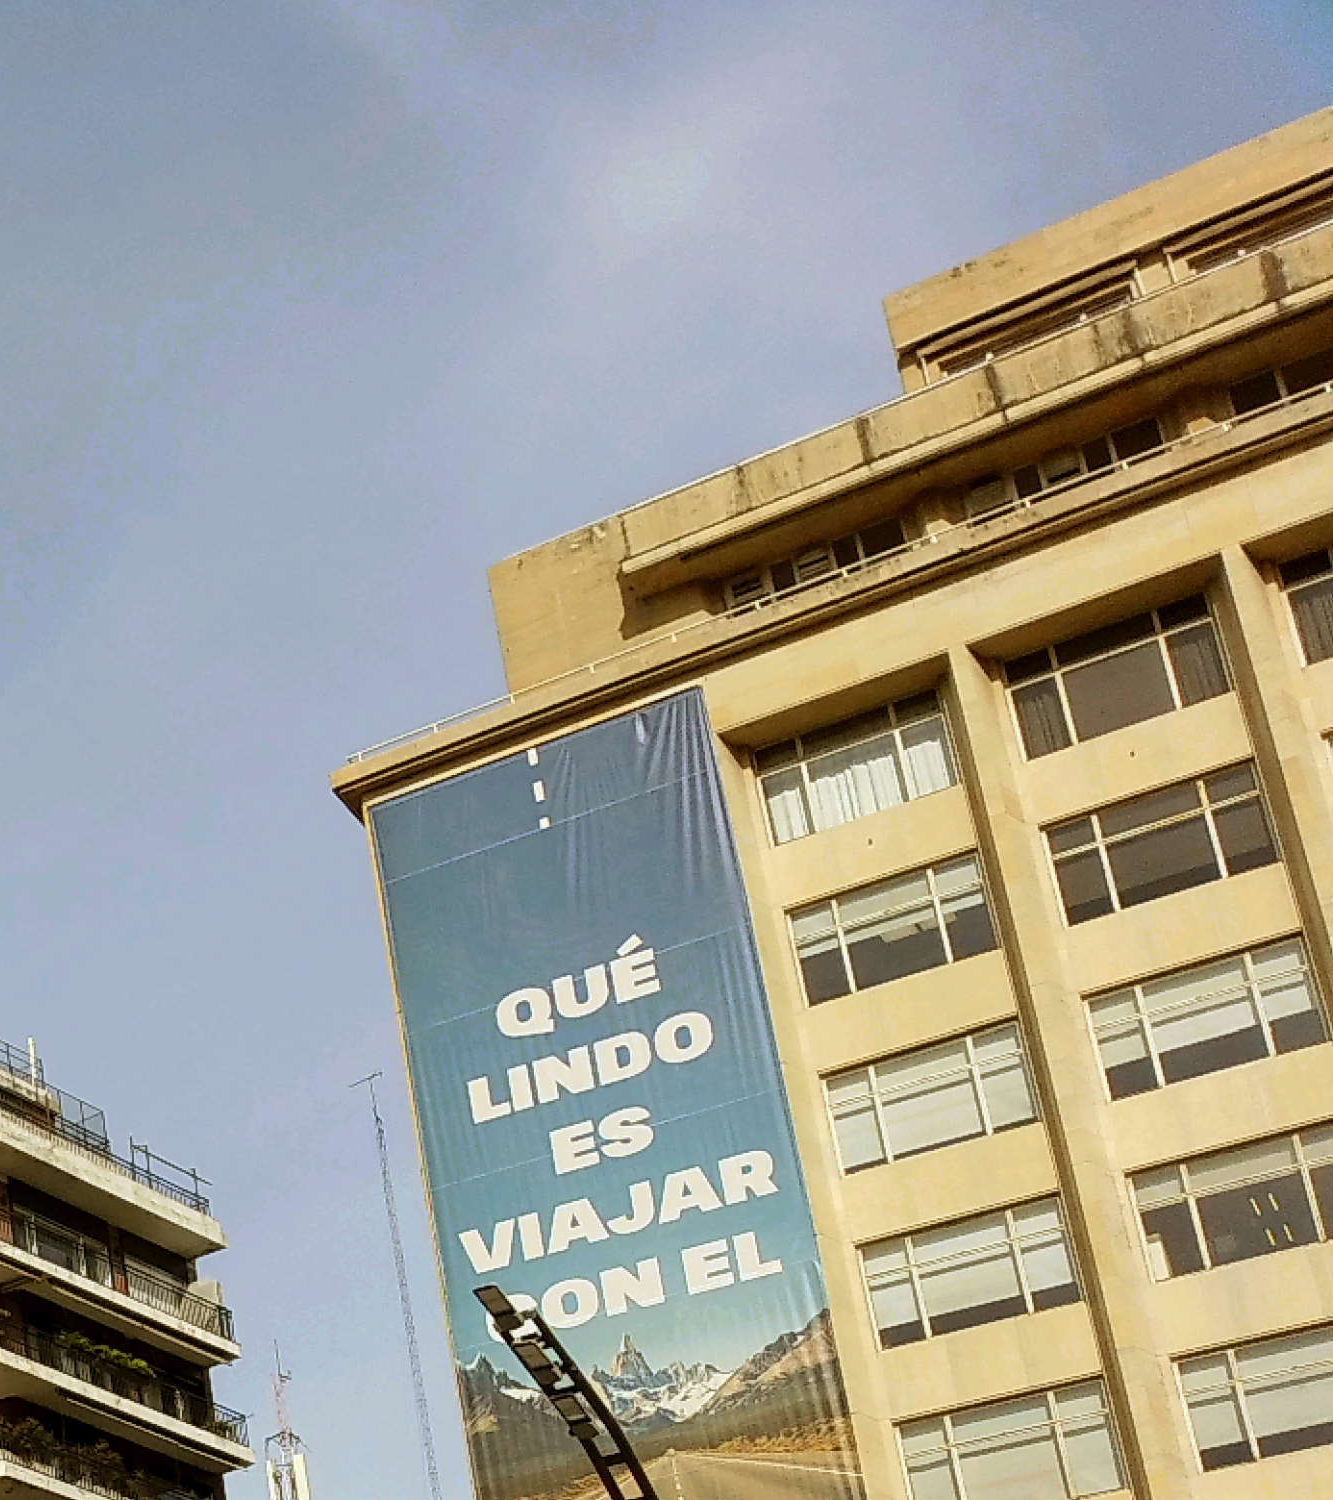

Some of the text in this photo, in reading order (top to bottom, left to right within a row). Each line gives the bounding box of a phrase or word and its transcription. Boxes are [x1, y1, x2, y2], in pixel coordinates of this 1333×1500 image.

[496, 934, 661, 1038] QUÉ
[466, 1010, 713, 1124] LINDO
[549, 1106, 654, 1175] ES
[459, 1150, 779, 1274] VIAJAR
[681, 1231, 783, 1296] EL
